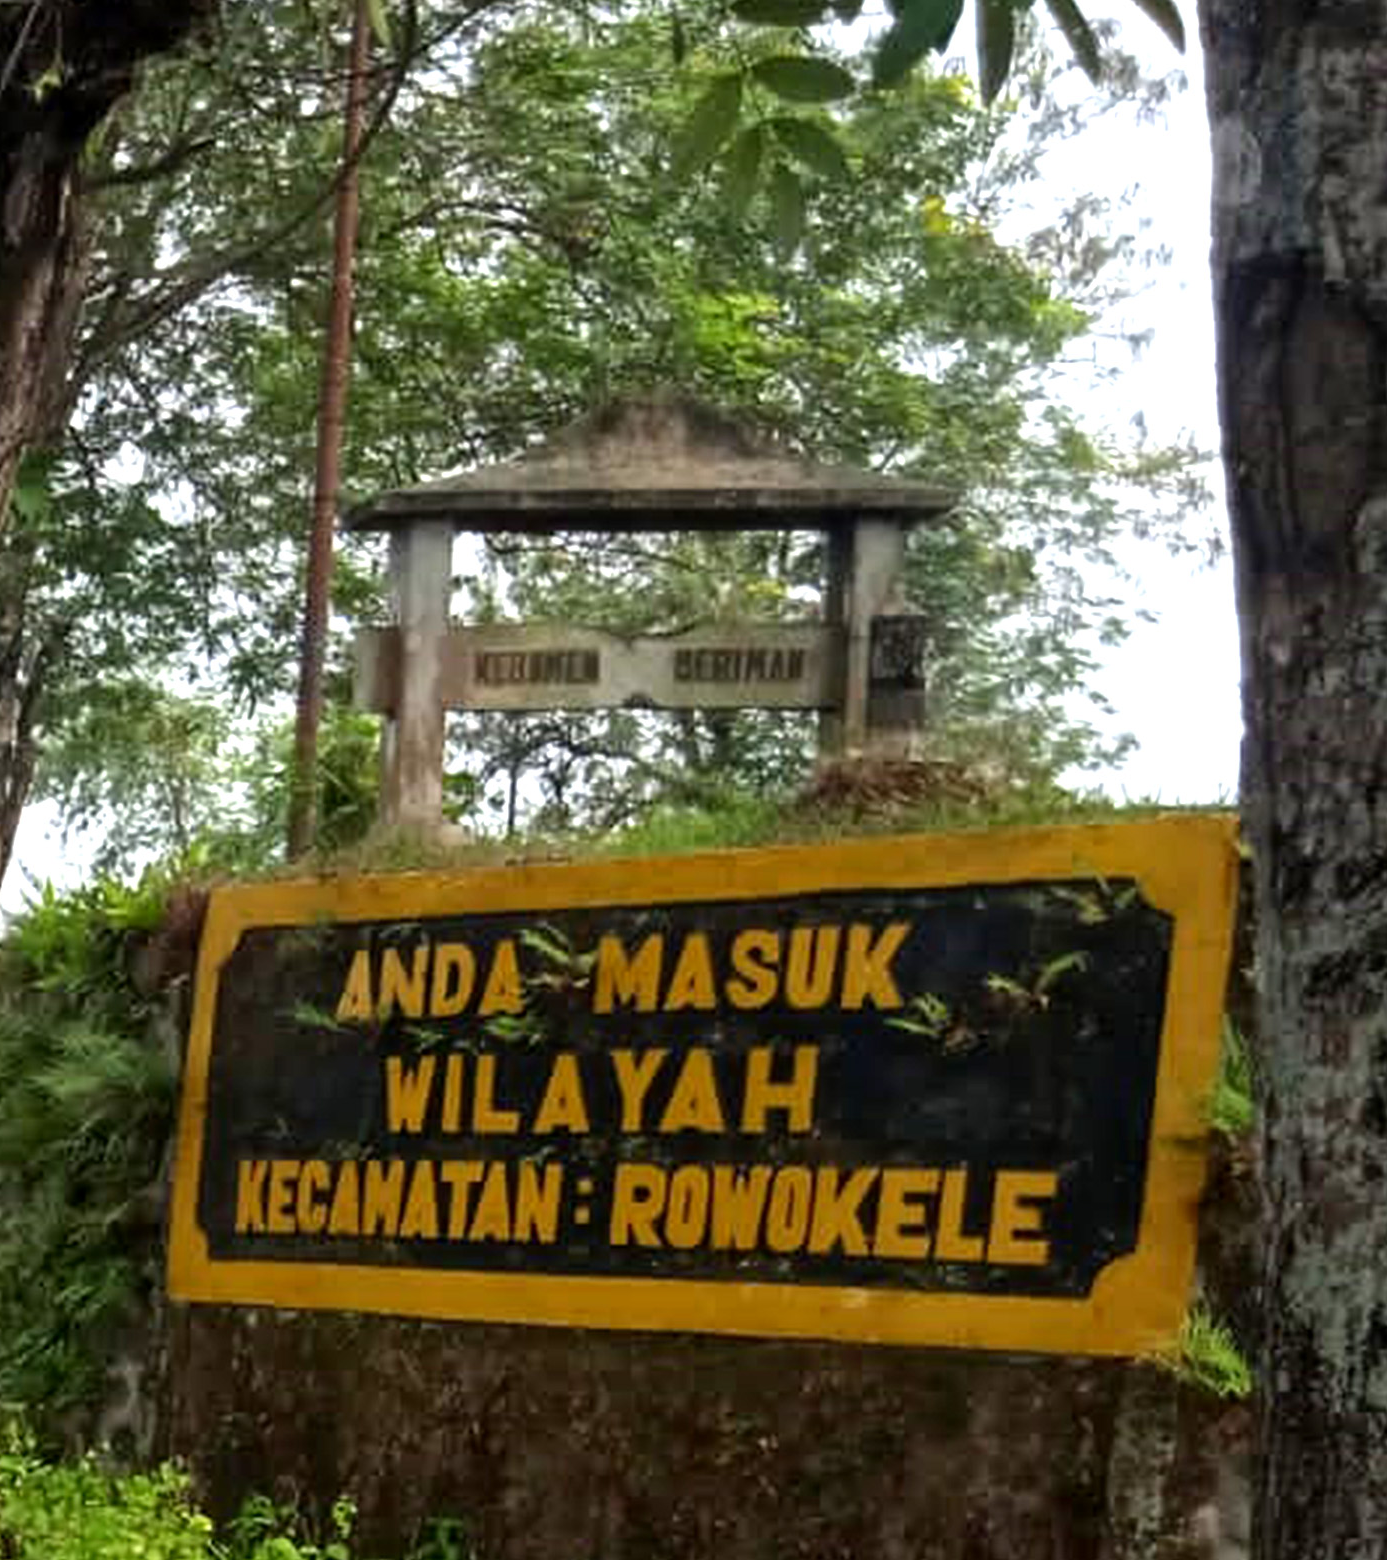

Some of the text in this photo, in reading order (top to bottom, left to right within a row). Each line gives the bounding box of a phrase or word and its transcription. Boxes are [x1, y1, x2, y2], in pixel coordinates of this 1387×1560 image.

[335, 922, 912, 1022] ANDA MASUK
[385, 1043, 819, 1135] WILAYAH
[610, 1163, 1057, 1266] ROWOKELE
